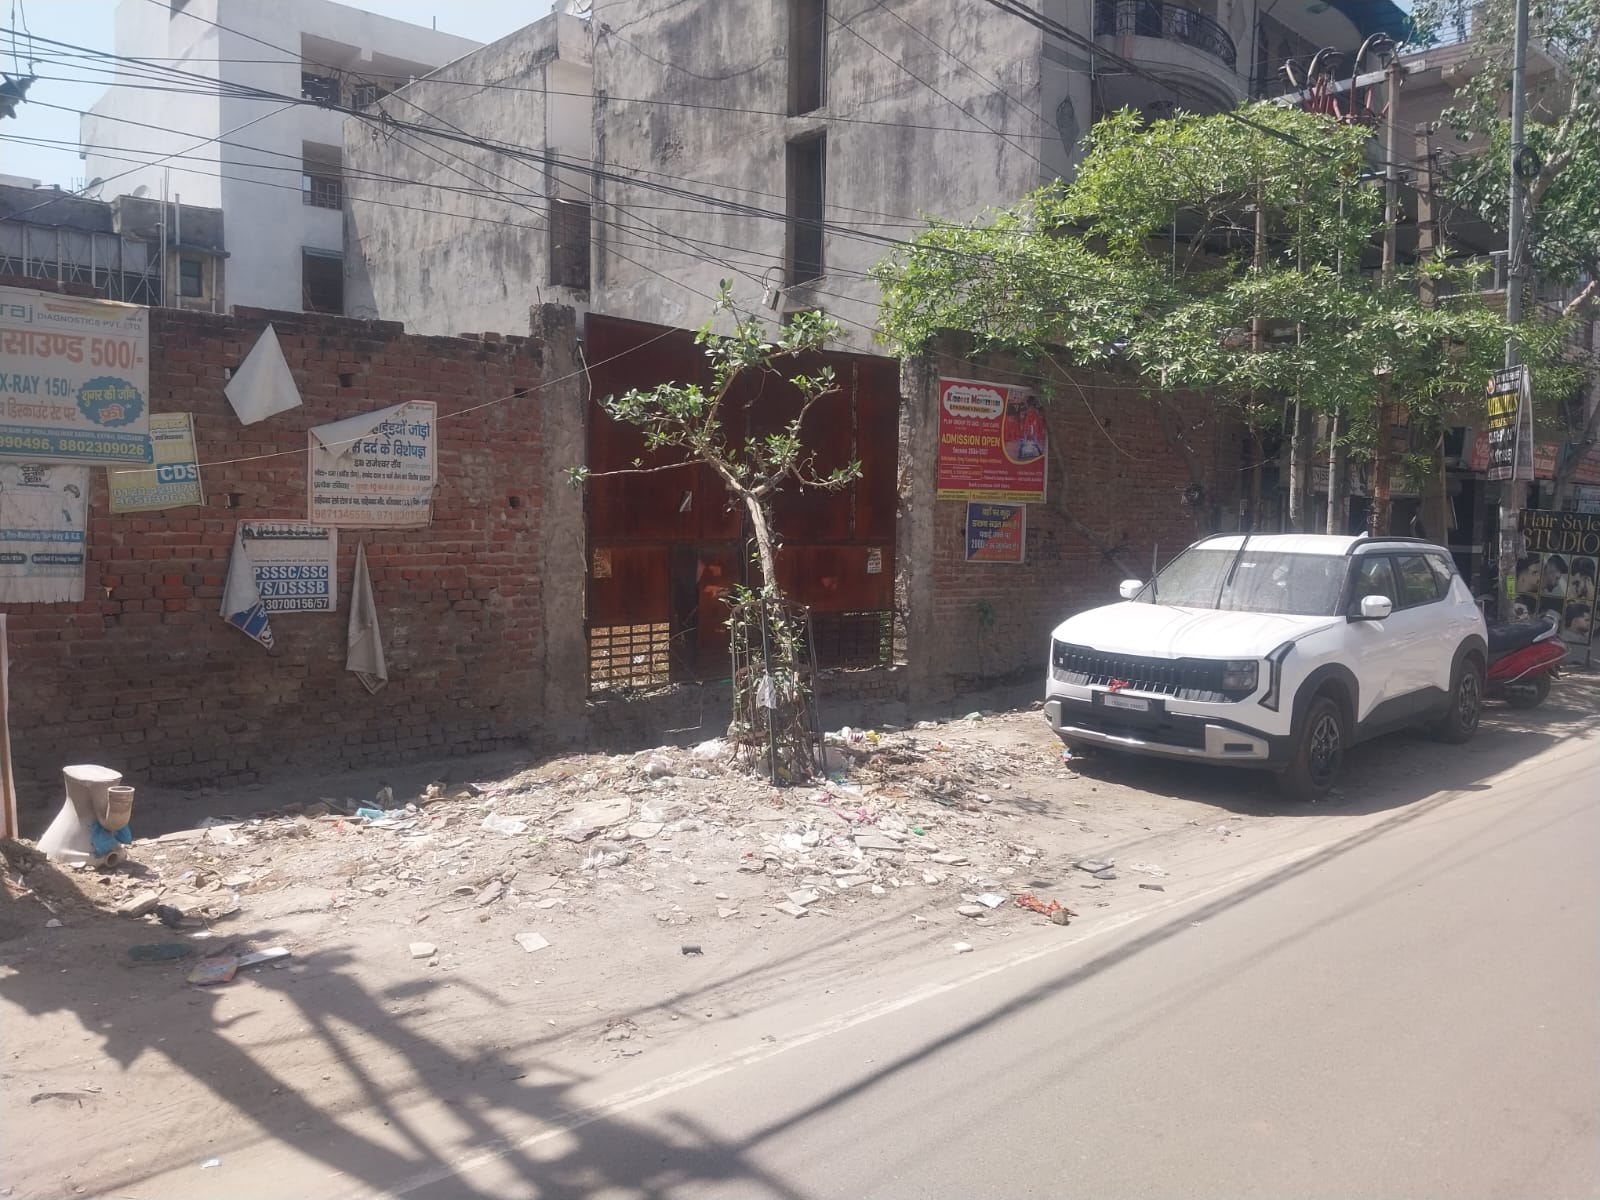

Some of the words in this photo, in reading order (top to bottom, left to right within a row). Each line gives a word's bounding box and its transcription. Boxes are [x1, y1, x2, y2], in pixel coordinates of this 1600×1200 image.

[37, 313, 100, 327] DIAGNOSTICS
[0, 373, 39, 394] X-RAY
[59, 439, 145, 455] 8802309026
[380, 440, 391, 455] के
[942, 433, 980, 446] ADMISSION
[981, 436, 1001, 447] OPEN
[160, 464, 196, 481] CDS
[1523, 511, 1557, 528] Hair
[1562, 514, 1600, 530] Style
[1522, 528, 1600, 553] STUDIO
